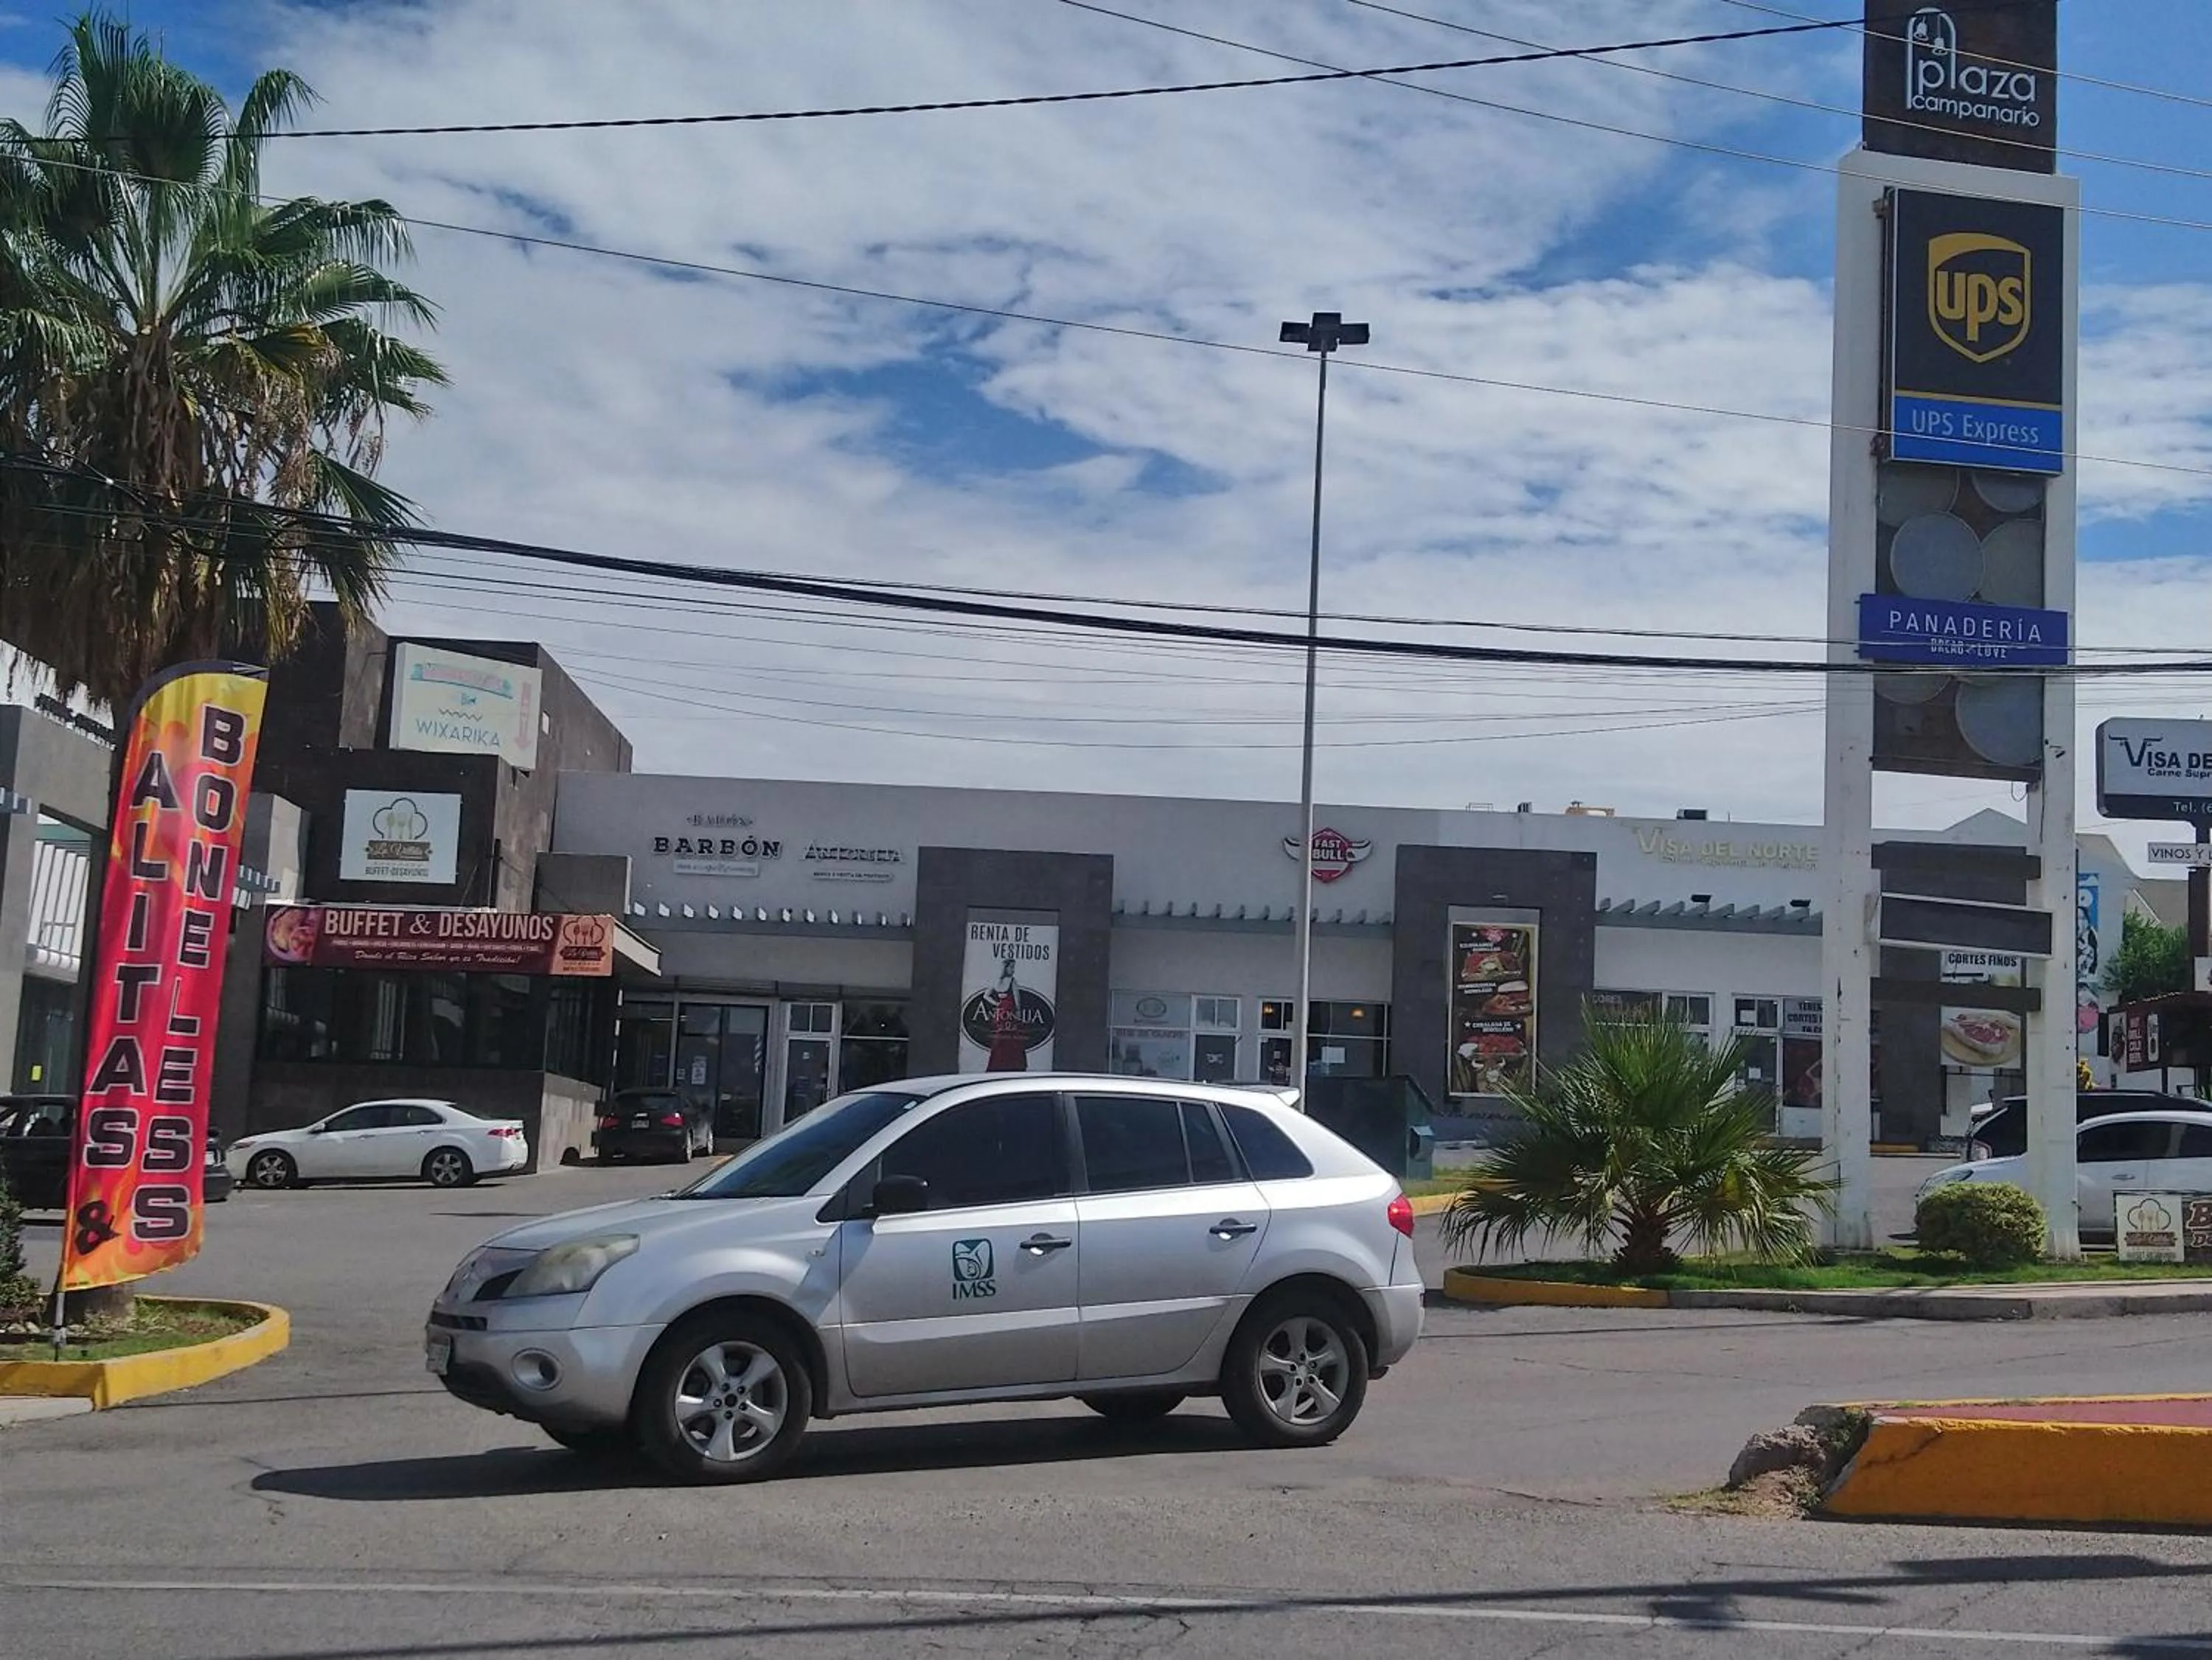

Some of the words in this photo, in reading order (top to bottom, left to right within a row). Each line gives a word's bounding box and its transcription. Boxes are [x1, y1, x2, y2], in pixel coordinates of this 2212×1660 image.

[1918, 57, 2036, 102] plaza
[1912, 94, 2040, 128] campanario
[1936, 271, 2025, 341] ups
[1911, 408, 1953, 436] UPS
[1962, 414, 2039, 444] Express
[1889, 610, 2042, 642] PANADERÍA
[416, 718, 501, 748] WIXARIKA
[2112, 736, 2181, 768] VISA
[2148, 767, 2181, 777] Carne
[653, 835, 780, 858] BARBÓN
[1312, 848, 1344, 860] BULL
[1748, 843, 1819, 861] NORTE
[2152, 848, 2191, 859] VINOS
[2195, 848, 2204, 859] Y
[324, 910, 404, 936] BUFFET
[409, 913, 432, 935] &
[439, 913, 554, 941] DESAYUNOS
[970, 924, 1009, 941] RENTA
[1015, 927, 1030, 942] DE
[83, 750, 181, 1169] ALITAS
[993, 943, 1050, 960] VESTIDOS
[1949, 953, 1986, 965] CORTES
[131, 702, 246, 1243] BONELESS
[952, 1279, 996, 1300] IMSS
